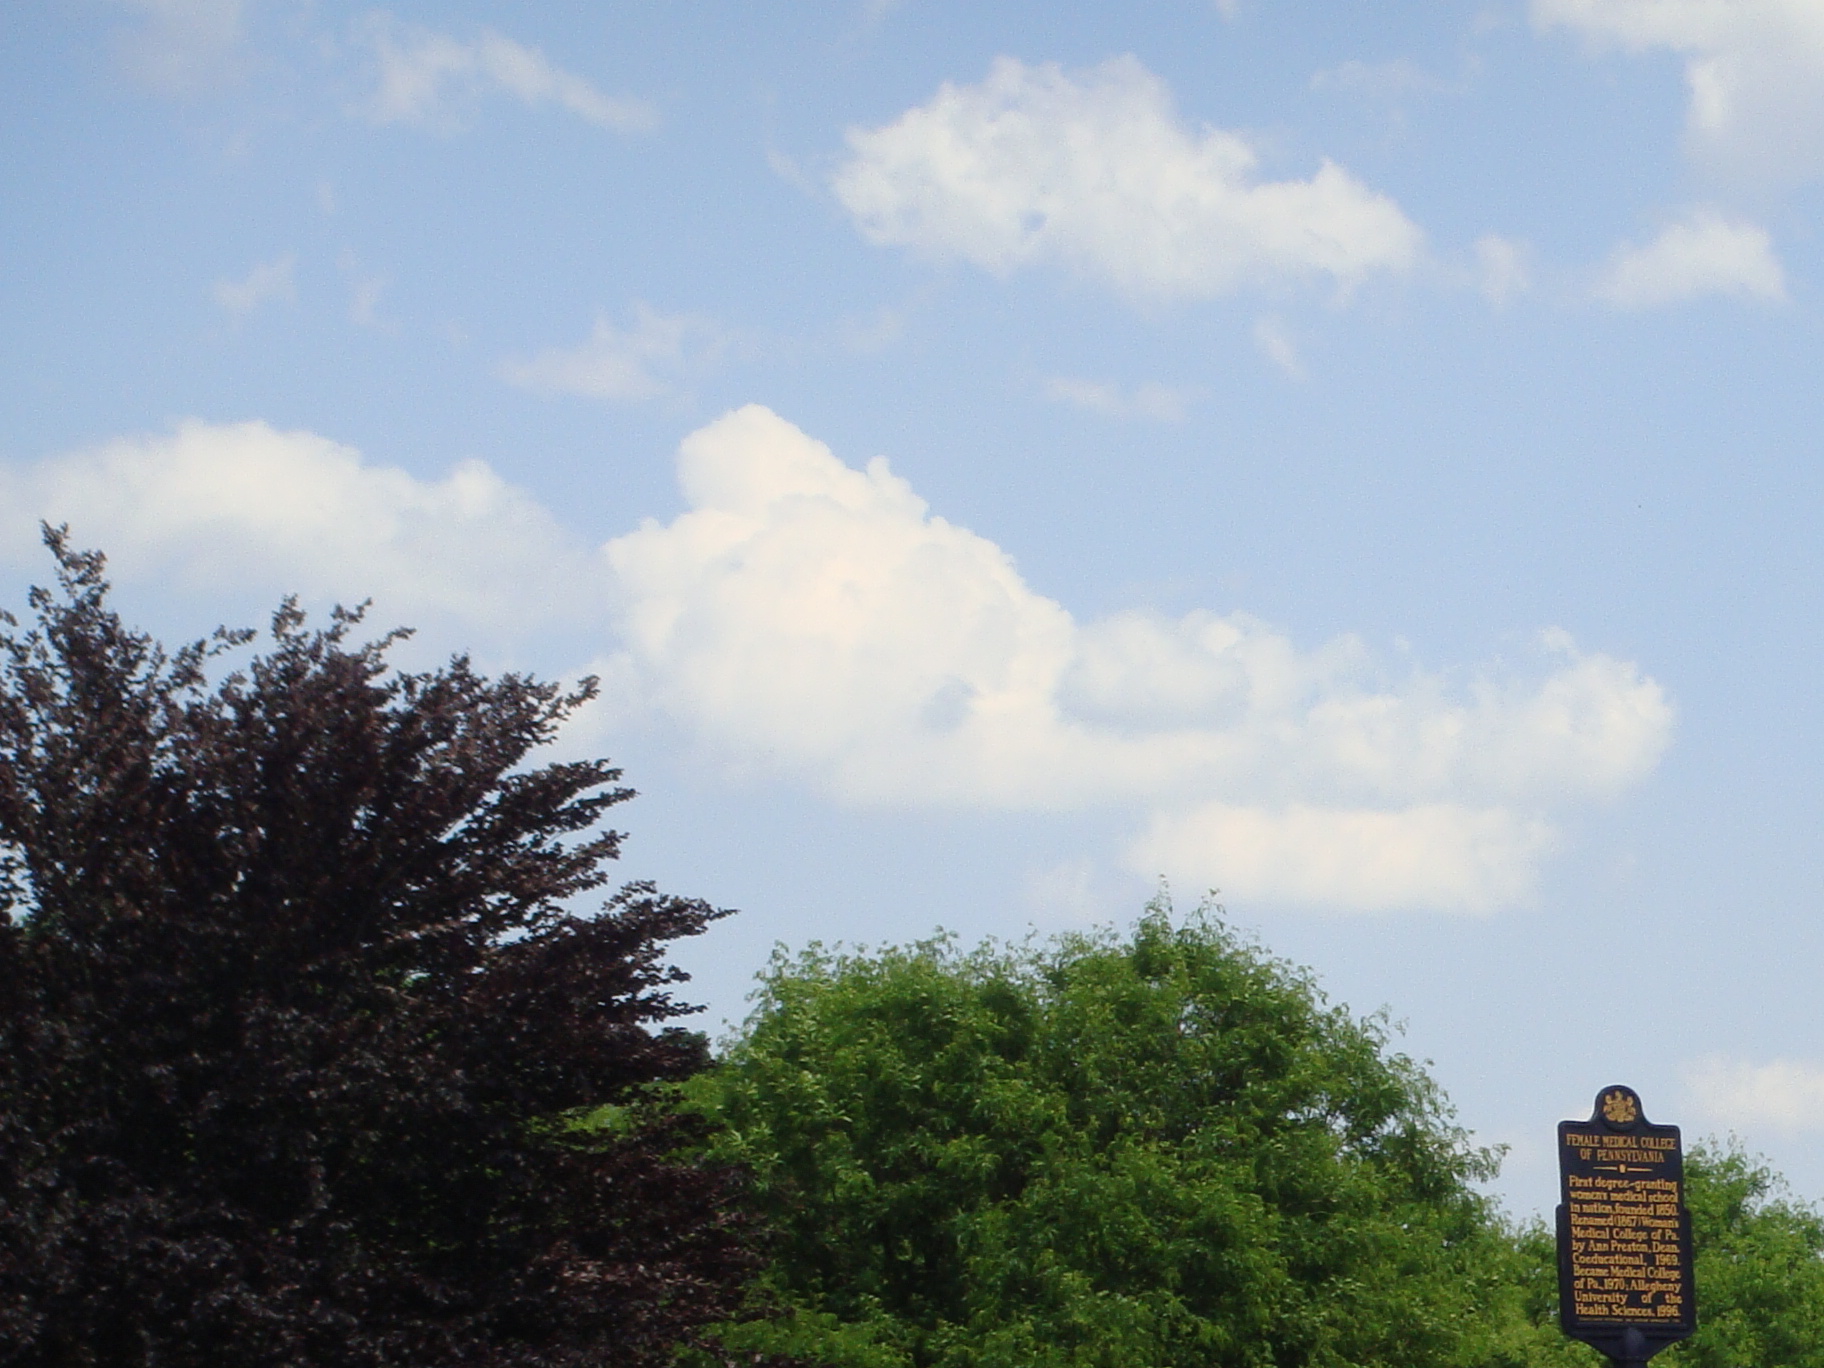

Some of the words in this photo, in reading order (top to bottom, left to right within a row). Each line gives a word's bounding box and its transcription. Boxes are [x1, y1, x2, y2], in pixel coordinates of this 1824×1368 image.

[1566, 1133, 1600, 1147] FEMALE
[1602, 1135, 1638, 1148] MEDICAL
[1641, 1136, 1677, 1150] COLLEGE
[1580, 1148, 1592, 1160] OF
[1597, 1149, 1665, 1163] PENNSYLVANIA
[1569, 1174, 1593, 1187] First
[1610, 1190, 1647, 1202] medical
[1648, 1191, 1679, 1203] school
[1615, 1203, 1654, 1215] founded
[1571, 1213, 1614, 1226] Renamed
[1571, 1226, 1610, 1239] Medical
[1612, 1228, 1648, 1242] College
[1651, 1229, 1662, 1240] of
[1665, 1229, 1679, 1241] Pa.
[1572, 1240, 1585, 1253] by
[1588, 1240, 1609, 1252] Ann
[1573, 1264, 1609, 1277] Became
[1610, 1265, 1646, 1278] Medical
[1647, 1266, 1681, 1281] College
[1574, 1278, 1585, 1289] of
[1630, 1279, 1682, 1294] Allegheny
[1574, 1290, 1628, 1305] University
[1641, 1292, 1653, 1303] of
[1665, 1292, 1683, 1304] the
[1575, 1302, 1609, 1315] Health
